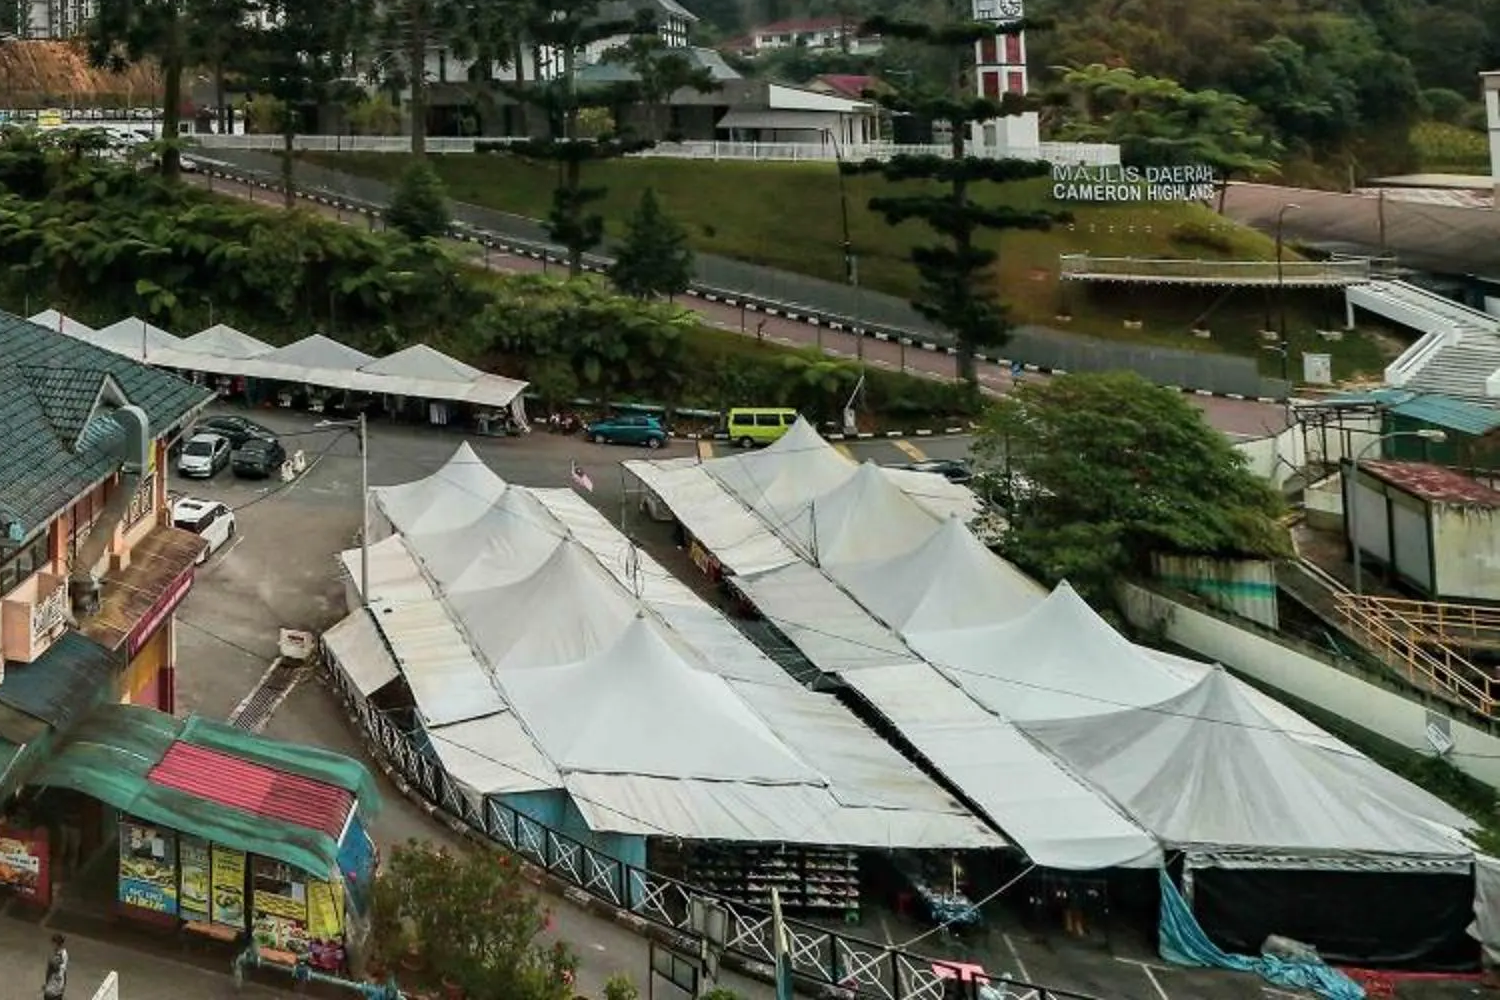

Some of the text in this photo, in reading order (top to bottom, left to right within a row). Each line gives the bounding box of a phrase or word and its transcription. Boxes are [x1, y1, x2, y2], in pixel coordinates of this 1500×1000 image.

[1053, 164, 1214, 183] MAJLIS DAERAH
[1053, 183, 1214, 201] CAMERON HIGHLANDS
